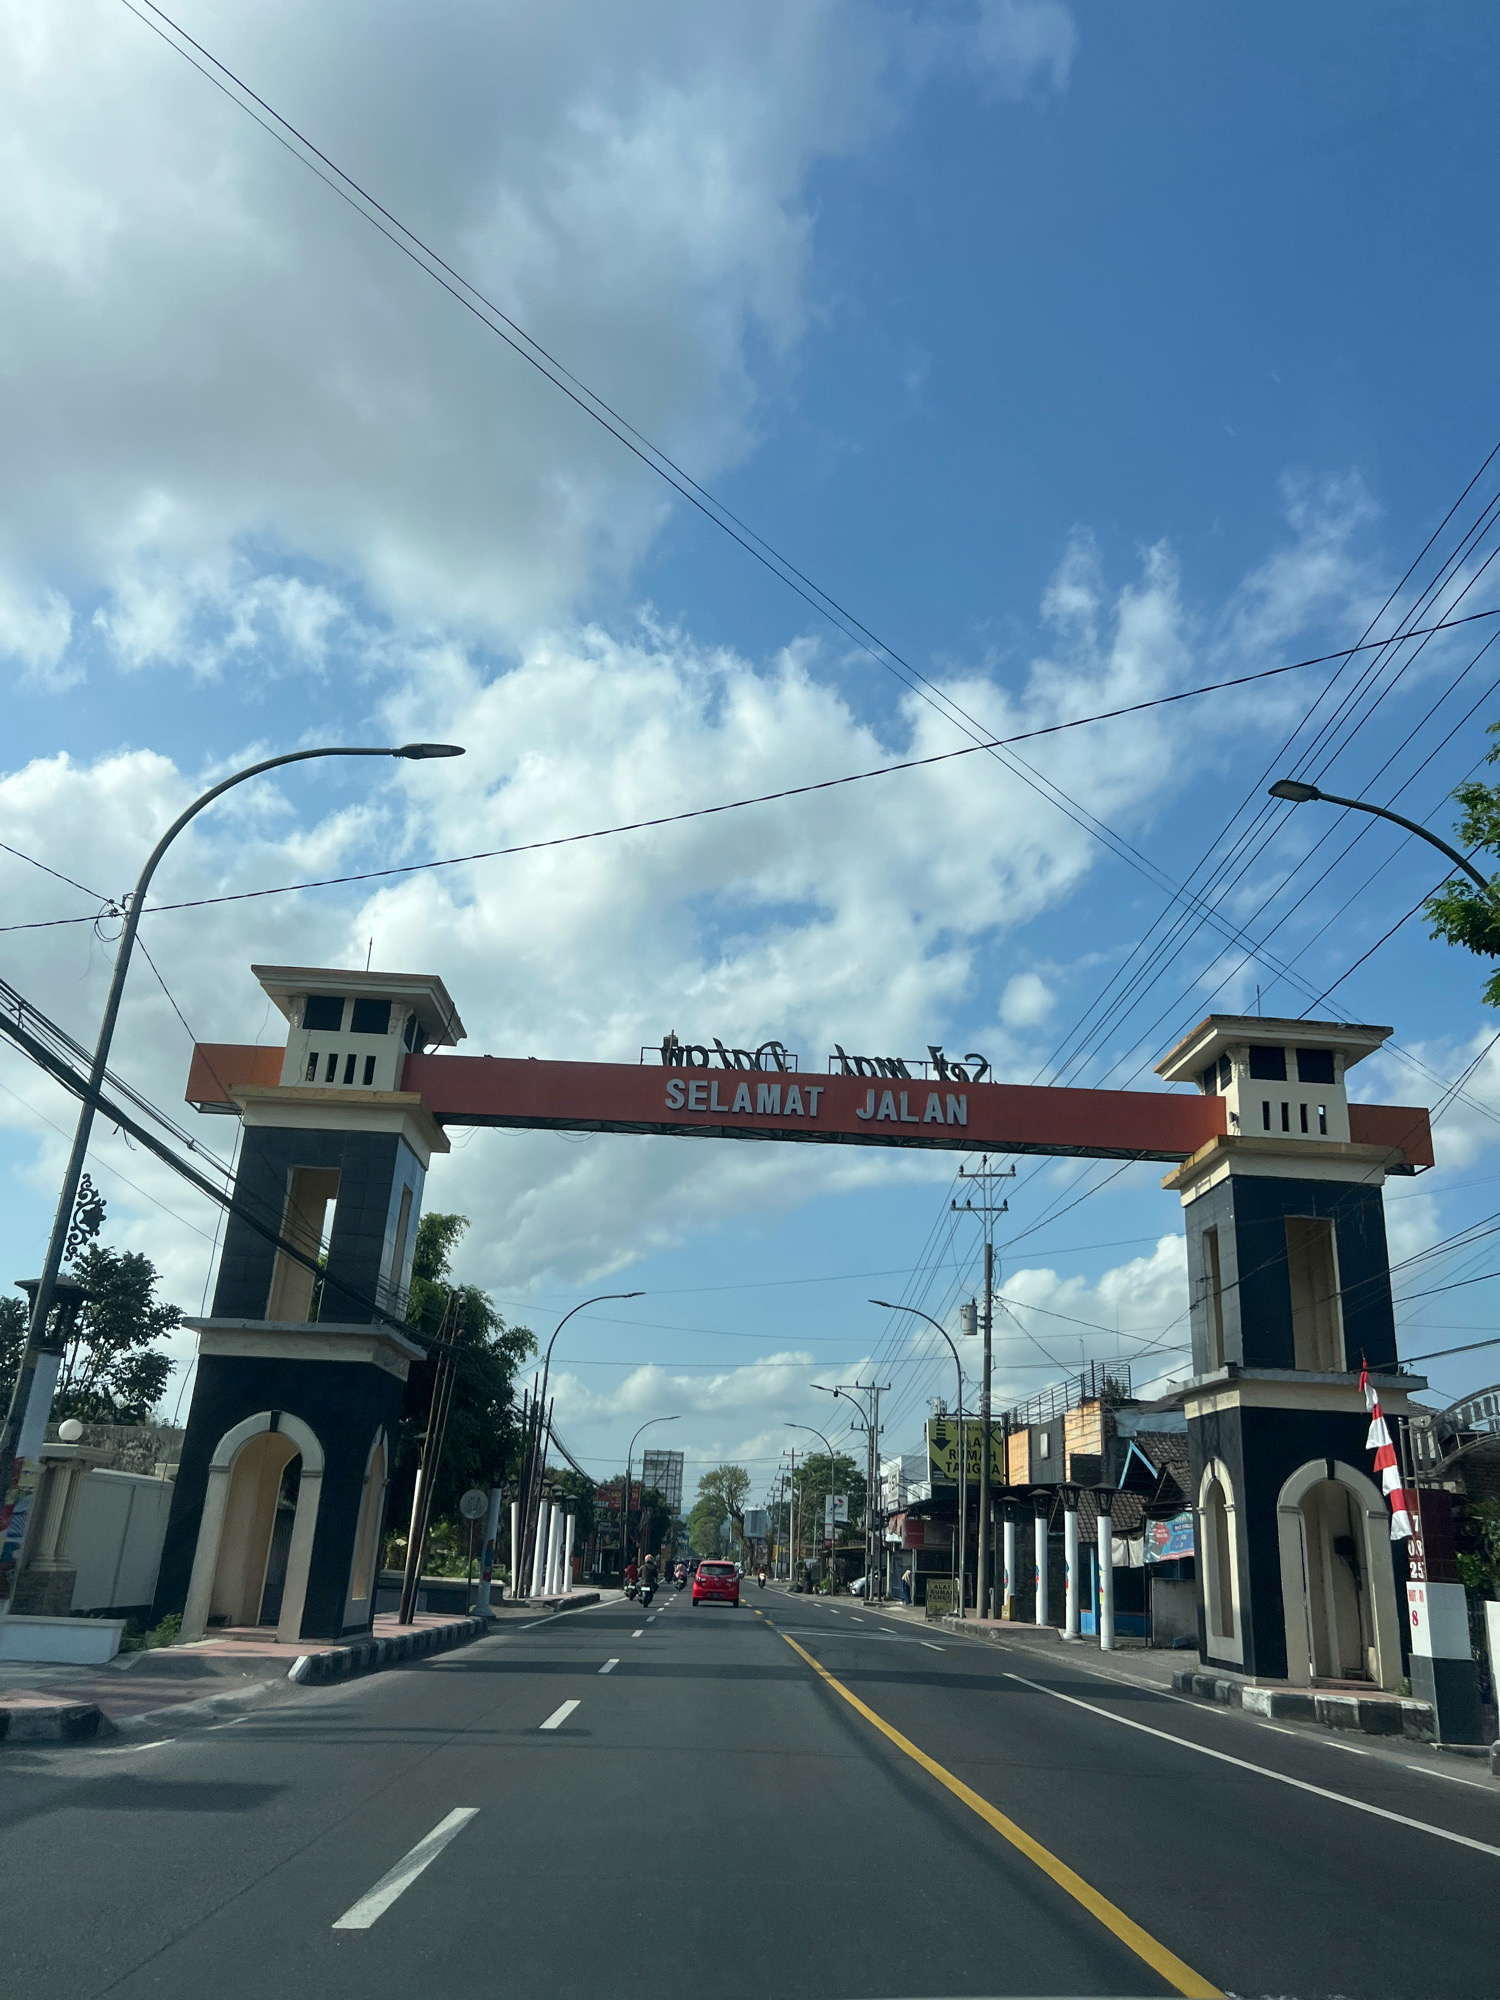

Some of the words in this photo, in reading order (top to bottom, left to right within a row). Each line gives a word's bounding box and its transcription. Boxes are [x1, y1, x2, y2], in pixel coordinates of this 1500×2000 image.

[665, 1078, 824, 1117] SELAMAT
[856, 1089, 967, 1126] JALAN
[949, 1449, 997, 1461] RUMH
[946, 1462, 1000, 1475] TANGA
[1410, 1561, 1425, 1579] 25
